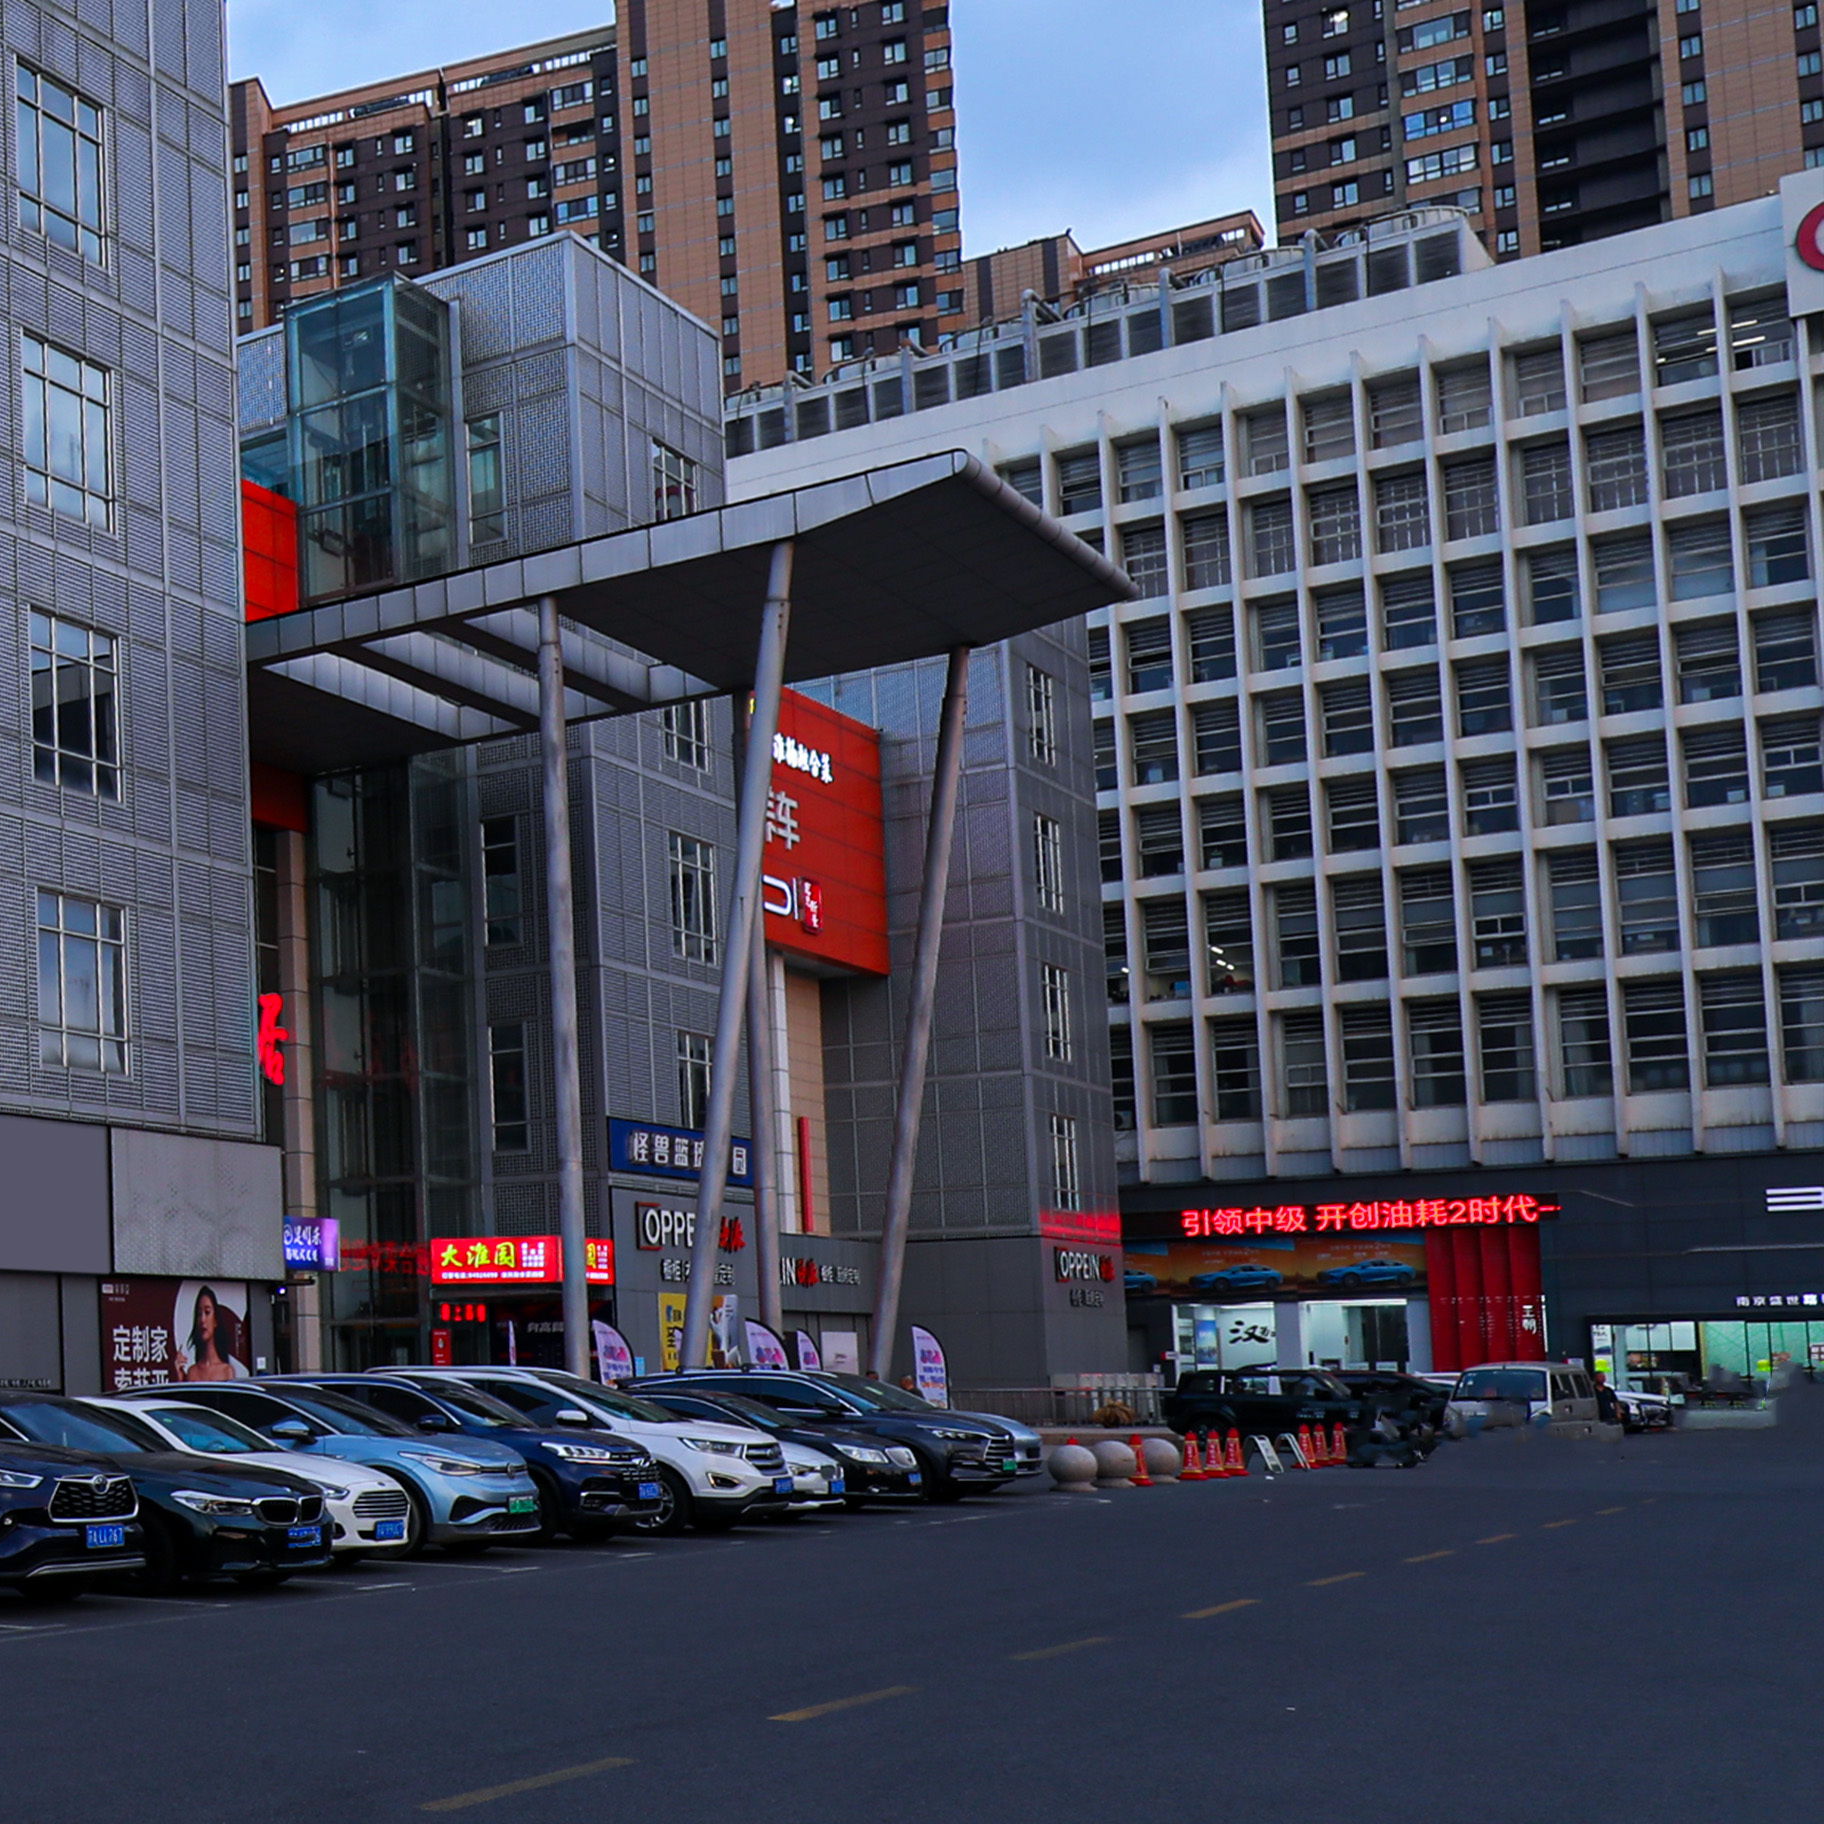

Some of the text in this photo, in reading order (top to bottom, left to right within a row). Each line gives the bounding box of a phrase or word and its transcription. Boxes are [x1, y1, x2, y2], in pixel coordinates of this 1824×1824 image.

[1181, 1204, 1308, 1238] 引领中级
[112, 1325, 169, 1363] 定制家
